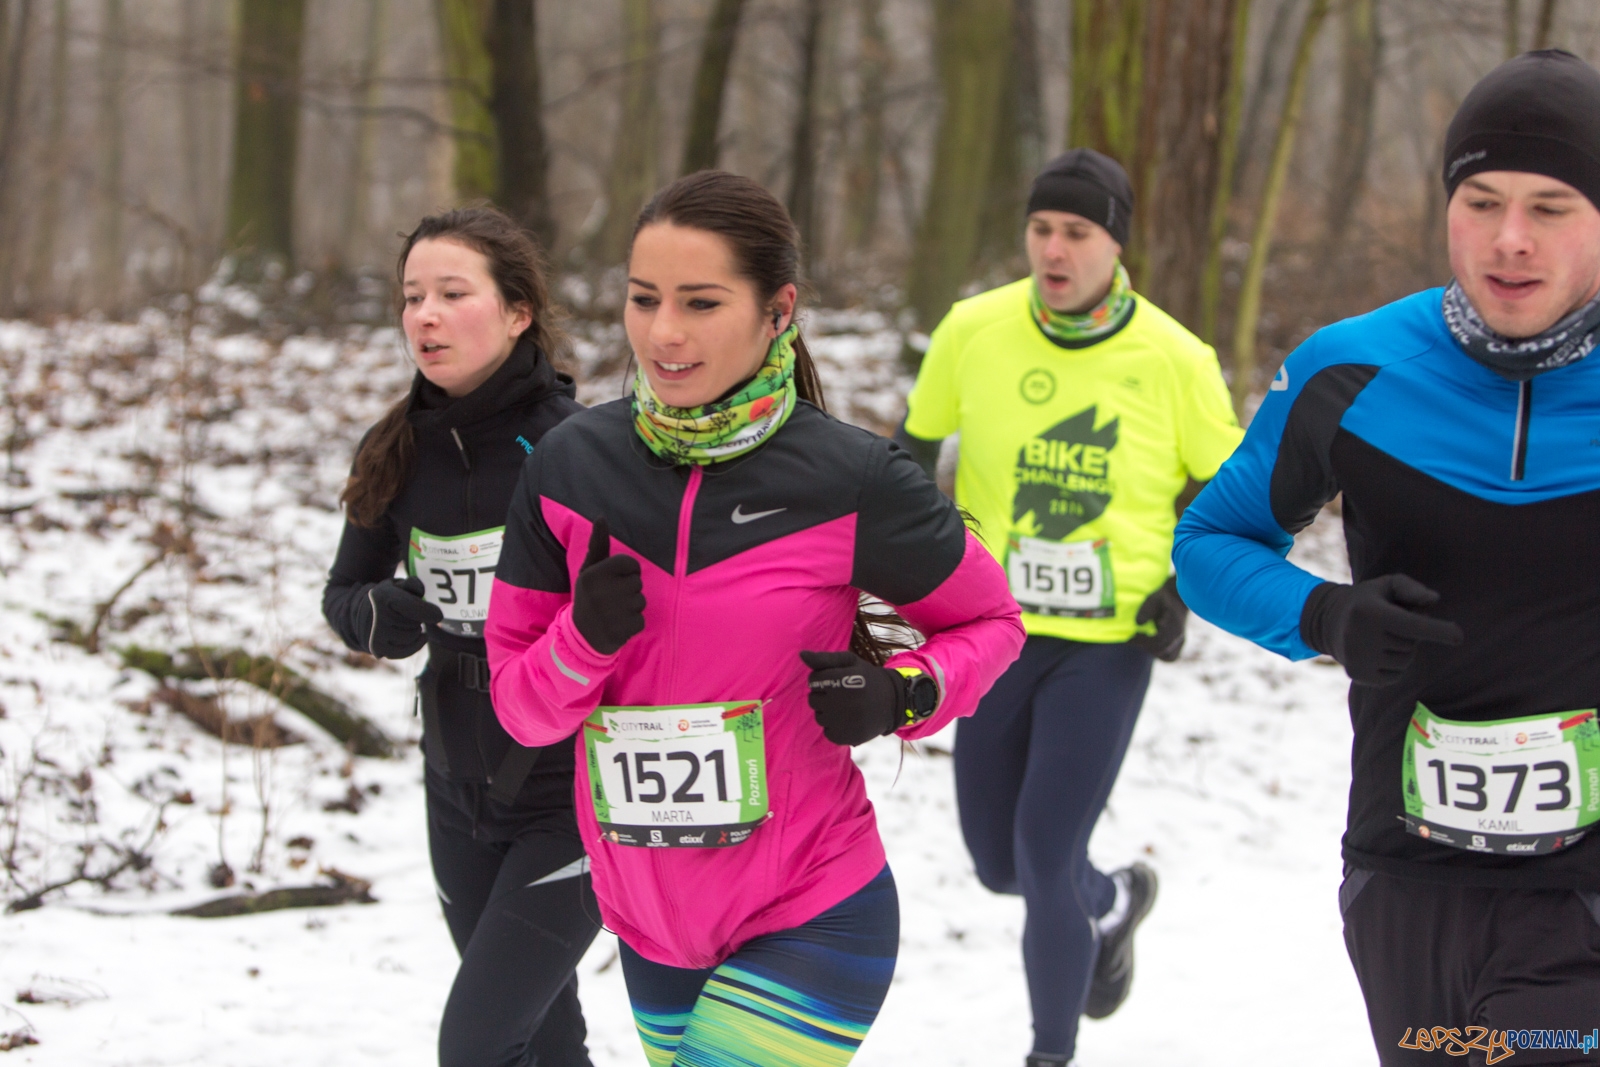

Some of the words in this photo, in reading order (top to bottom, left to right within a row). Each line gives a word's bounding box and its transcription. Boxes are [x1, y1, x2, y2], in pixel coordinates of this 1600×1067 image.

[1025, 437, 1107, 476] BIKE
[1020, 561, 1094, 595] 1519
[613, 749, 728, 803] 1521
[745, 758, 761, 806] Poznań
[1428, 758, 1571, 813] 1373
[1585, 767, 1600, 812] Poznań
[651, 810, 694, 823] MARTA
[1477, 818, 1524, 832] KAMIL
